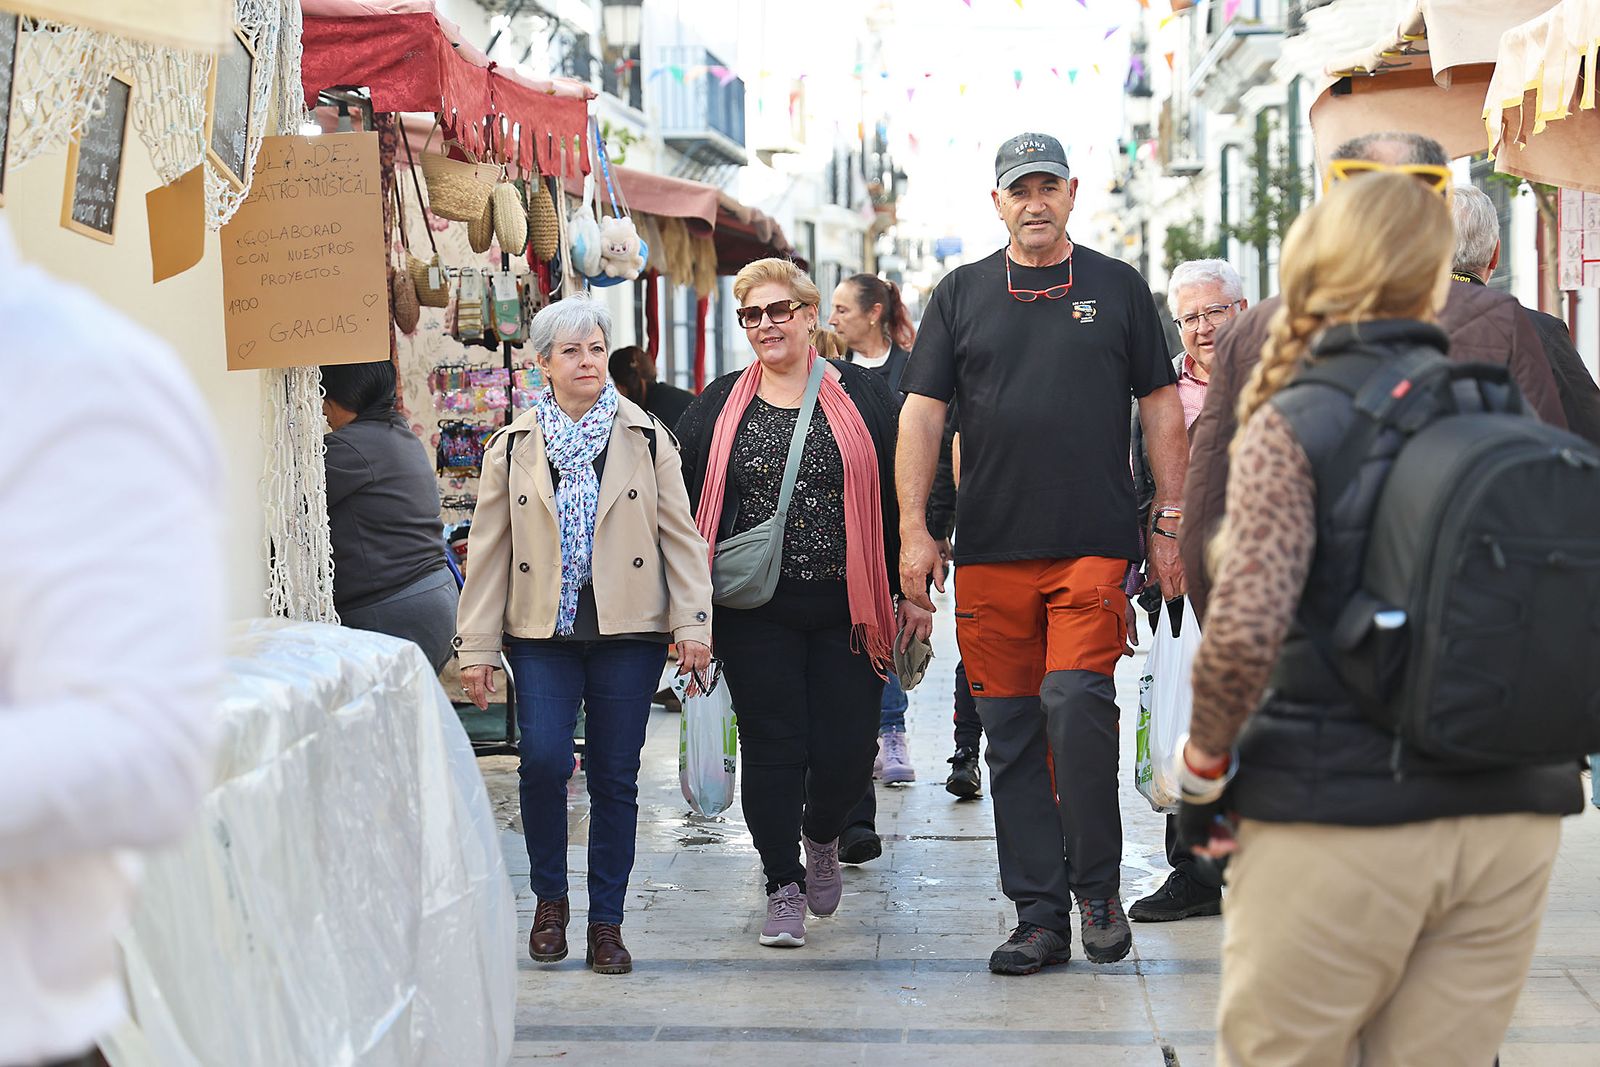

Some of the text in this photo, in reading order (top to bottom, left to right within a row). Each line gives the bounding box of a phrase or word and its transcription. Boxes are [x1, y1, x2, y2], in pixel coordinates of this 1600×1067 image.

[313, 144, 348, 167] DE
[243, 178, 376, 204] EATRO MUSICAL
[242, 221, 342, 246] COLABORAD
[235, 241, 355, 265] CON NUESTROS
[260, 265, 341, 286] PROYECTOS
[269, 314, 358, 342] GRACIAS
